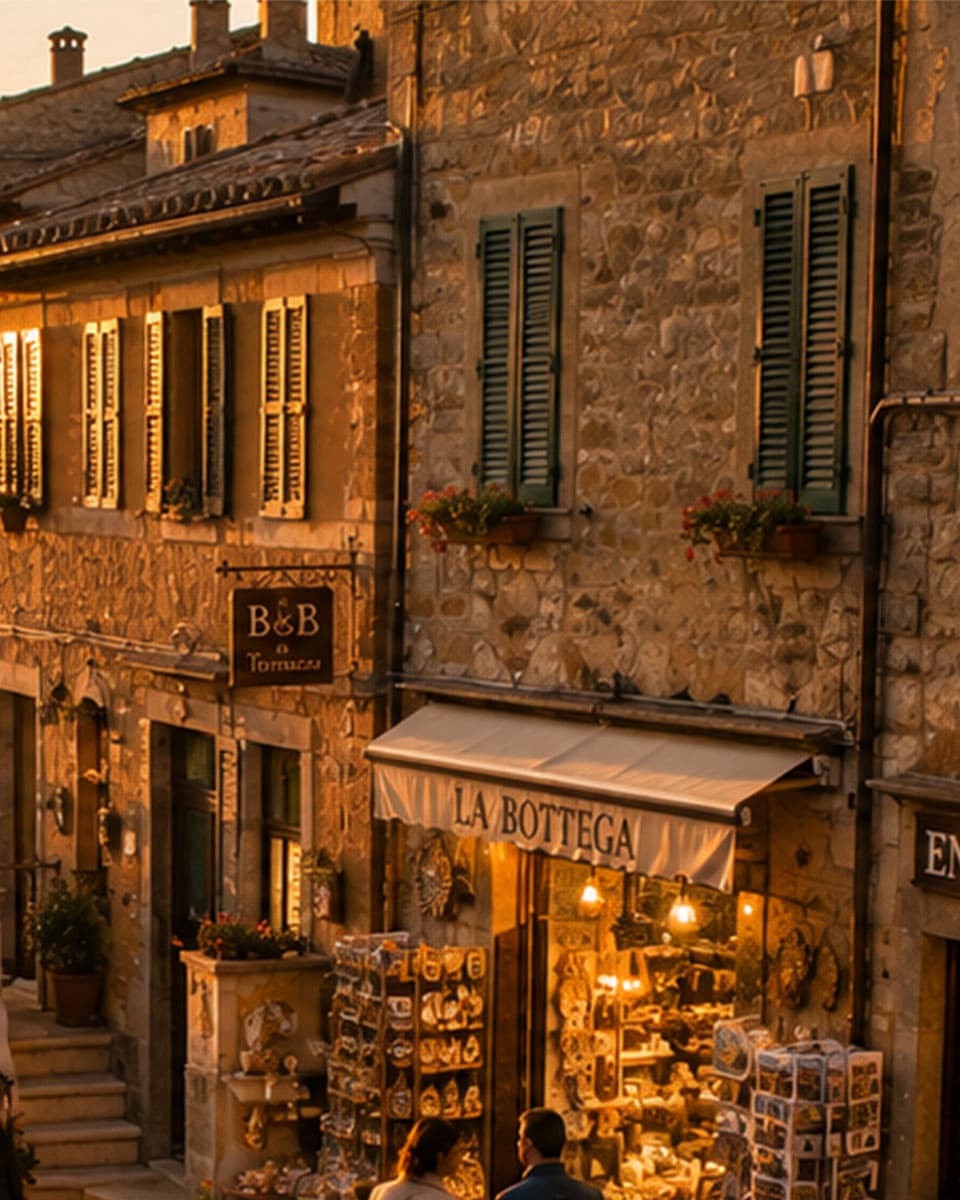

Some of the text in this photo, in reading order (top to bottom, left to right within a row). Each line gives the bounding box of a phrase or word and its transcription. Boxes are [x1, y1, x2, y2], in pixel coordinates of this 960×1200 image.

[247, 601, 320, 637] B&B
[454, 785, 635, 860] LA BOTTEGA
